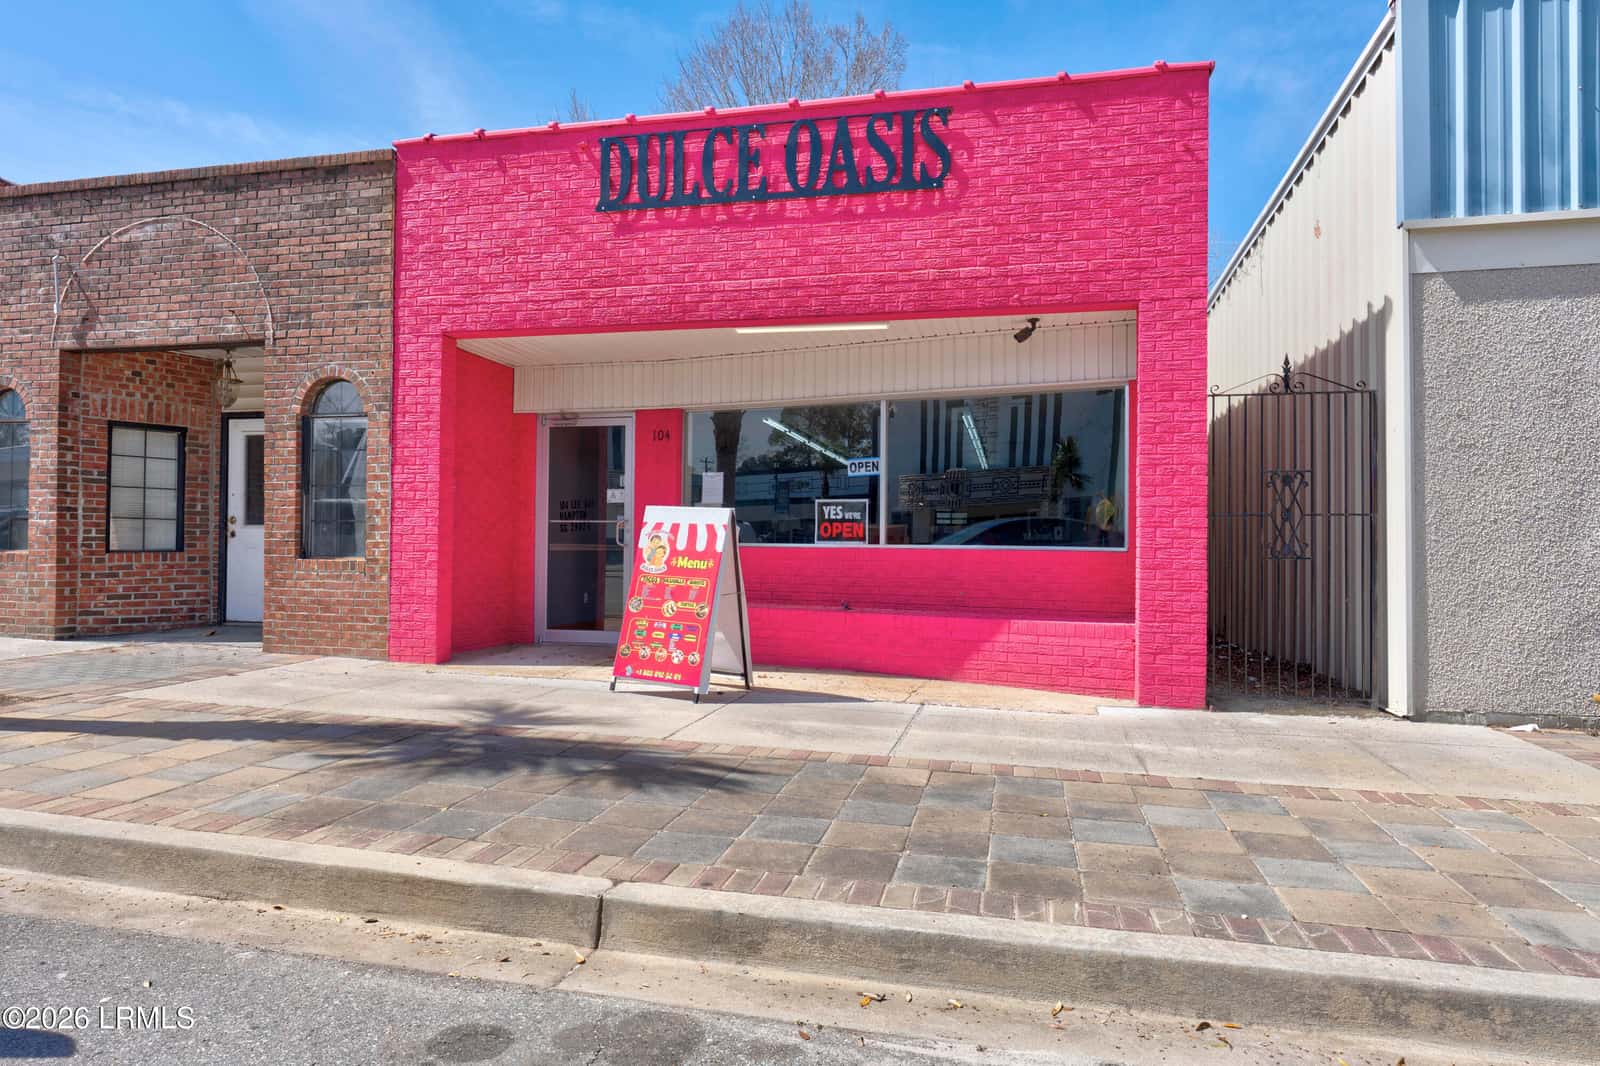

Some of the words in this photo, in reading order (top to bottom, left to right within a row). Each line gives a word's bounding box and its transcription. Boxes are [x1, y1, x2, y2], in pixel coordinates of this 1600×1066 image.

[597, 125, 766, 211] DULCE
[783, 107, 953, 195] OASIS
[652, 430, 670, 441] 104
[849, 461, 879, 473] OPEN
[822, 505, 843, 519] YES
[819, 522, 864, 539] OPEN
[677, 556, 708, 569] Menu
